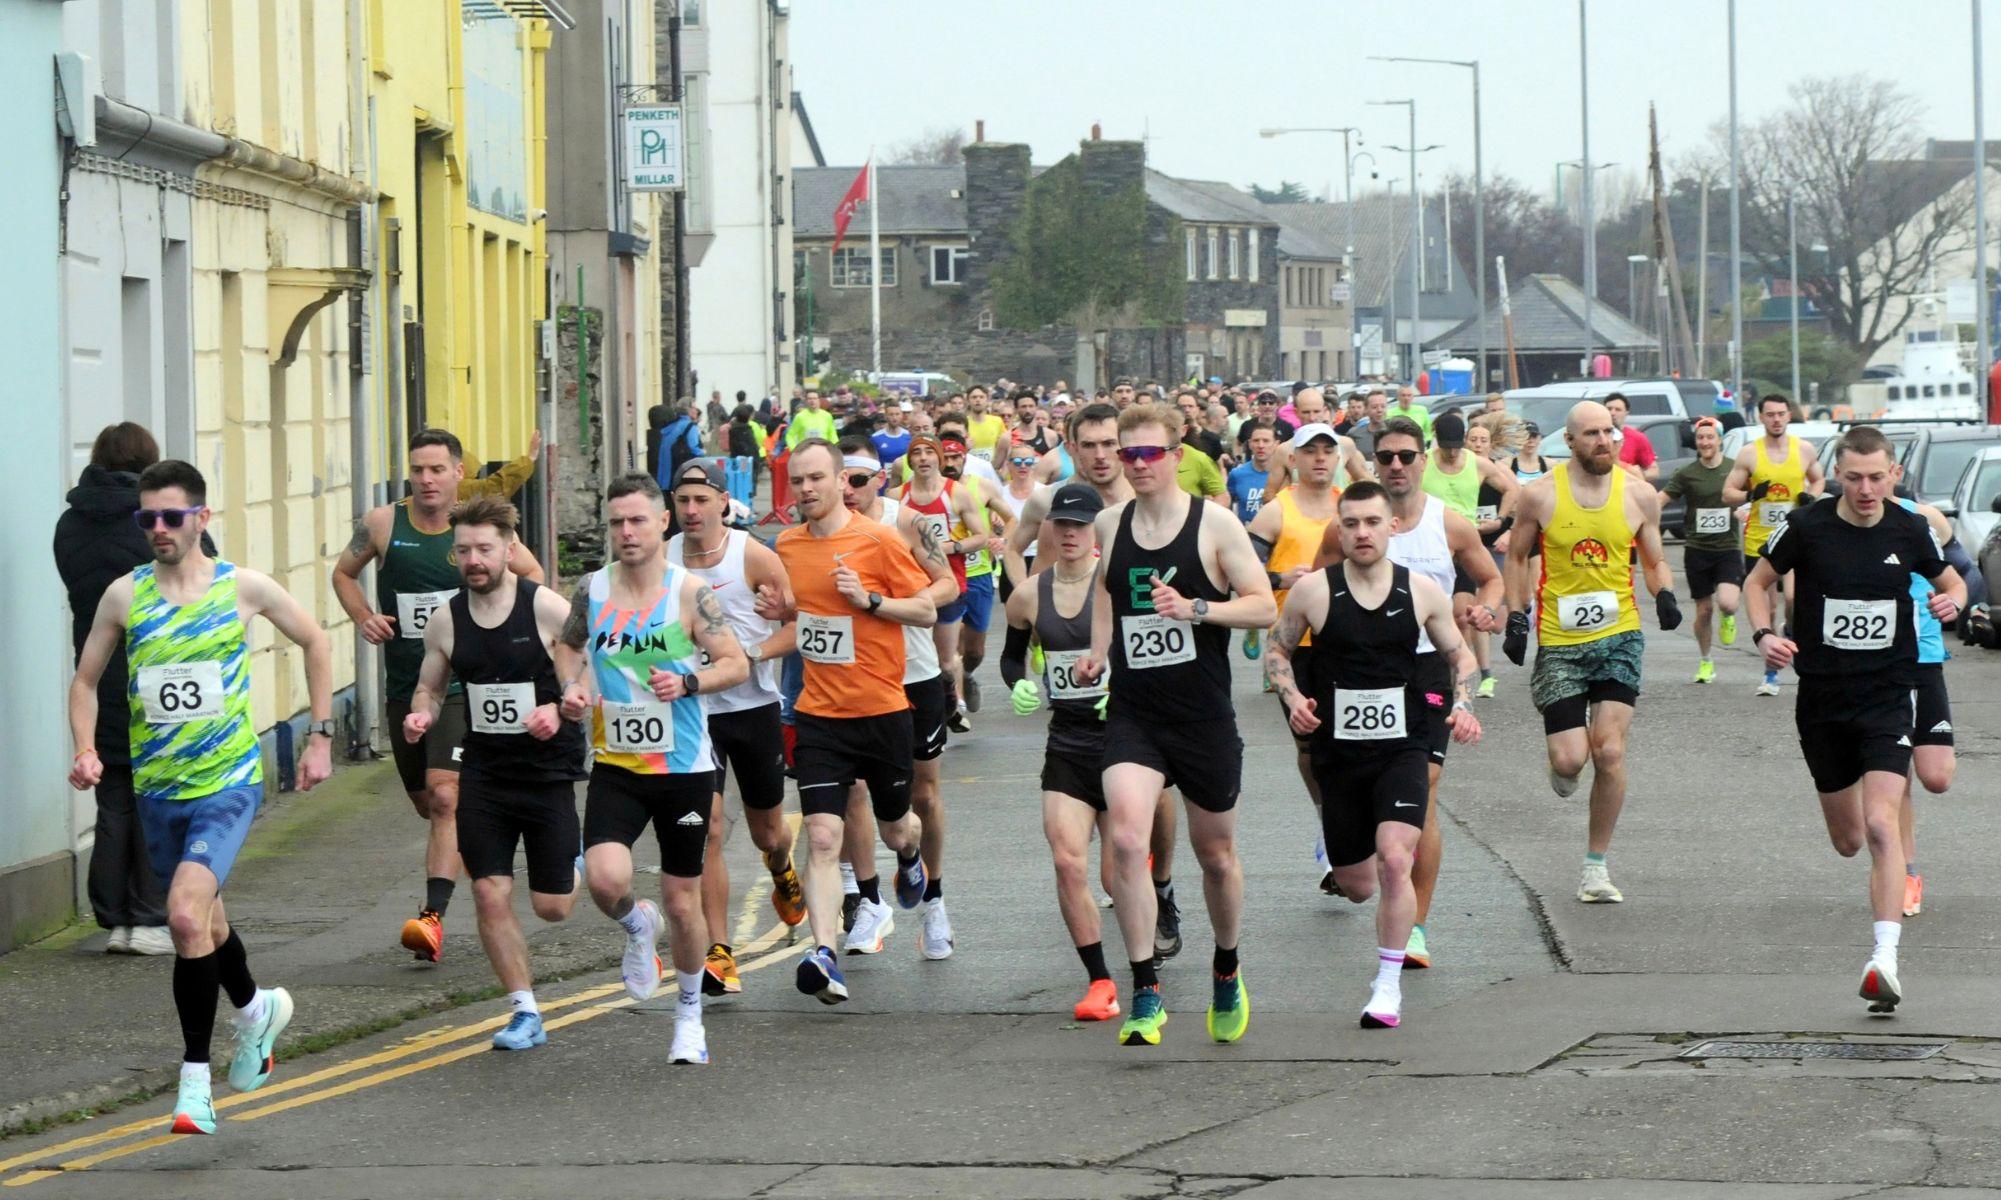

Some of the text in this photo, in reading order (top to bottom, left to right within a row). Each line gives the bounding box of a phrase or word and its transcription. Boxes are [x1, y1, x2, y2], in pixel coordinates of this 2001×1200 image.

[628, 110, 679, 120] PENKETH
[635, 174, 675, 184] MILLAR
[1701, 515, 1726, 528] 233
[413, 606, 440, 630] 5
[1574, 604, 1605, 627] 23
[1832, 614, 1887, 640] 282
[595, 631, 668, 654] BERLIN
[802, 627, 843, 654] 257
[1130, 627, 1184, 658] 230
[163, 668, 193, 677] Flutter
[160, 681, 202, 712] 63
[482, 700, 519, 724] 95
[1343, 704, 1396, 730] 286
[611, 717, 664, 744] 130
